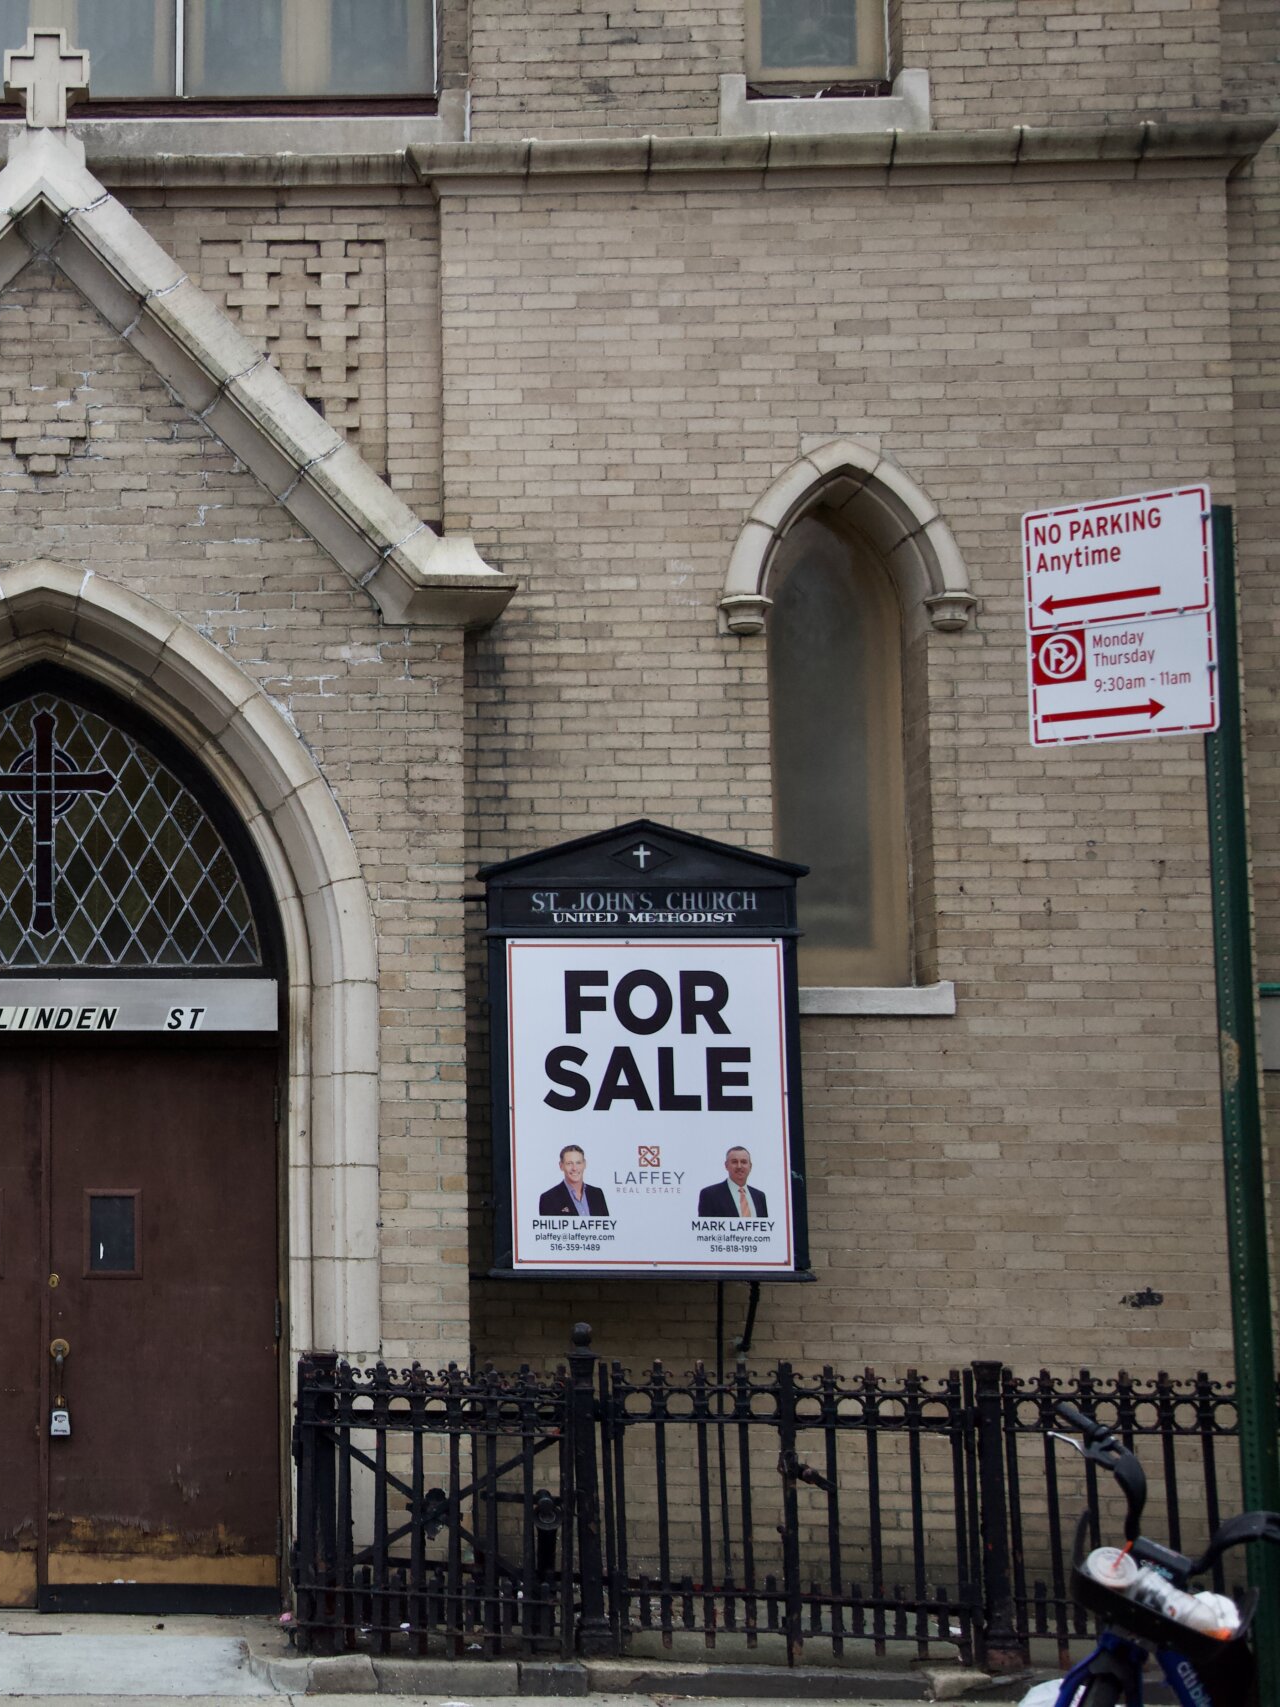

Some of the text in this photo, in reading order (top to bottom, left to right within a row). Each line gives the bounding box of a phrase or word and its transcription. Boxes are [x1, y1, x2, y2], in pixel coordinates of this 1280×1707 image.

[1034, 508, 1161, 546] NO PARKING
[1036, 546, 1121, 574] Anytime
[1093, 631, 1144, 648] Monday
[1094, 649, 1155, 666] Thursday
[1094, 676, 1145, 693] 9:30am
[1160, 672, 1191, 685] 11am
[666, 892, 757, 910] CHURCH
[553, 913, 736, 923] UNITED METHODIST
[564, 969, 732, 1035] FOR
[166, 1008, 205, 1029] ST
[543, 1045, 753, 1112] SALE
[614, 1172, 684, 1184] LAFFEY
[532, 1220, 617, 1230] PHILIP LAFFEY
[692, 1221, 775, 1231] MARK LAFFEY
[535, 1233, 614, 1241] plaffey@laffeyre.com
[697, 1234, 770, 1243] mark@laffeyre.com
